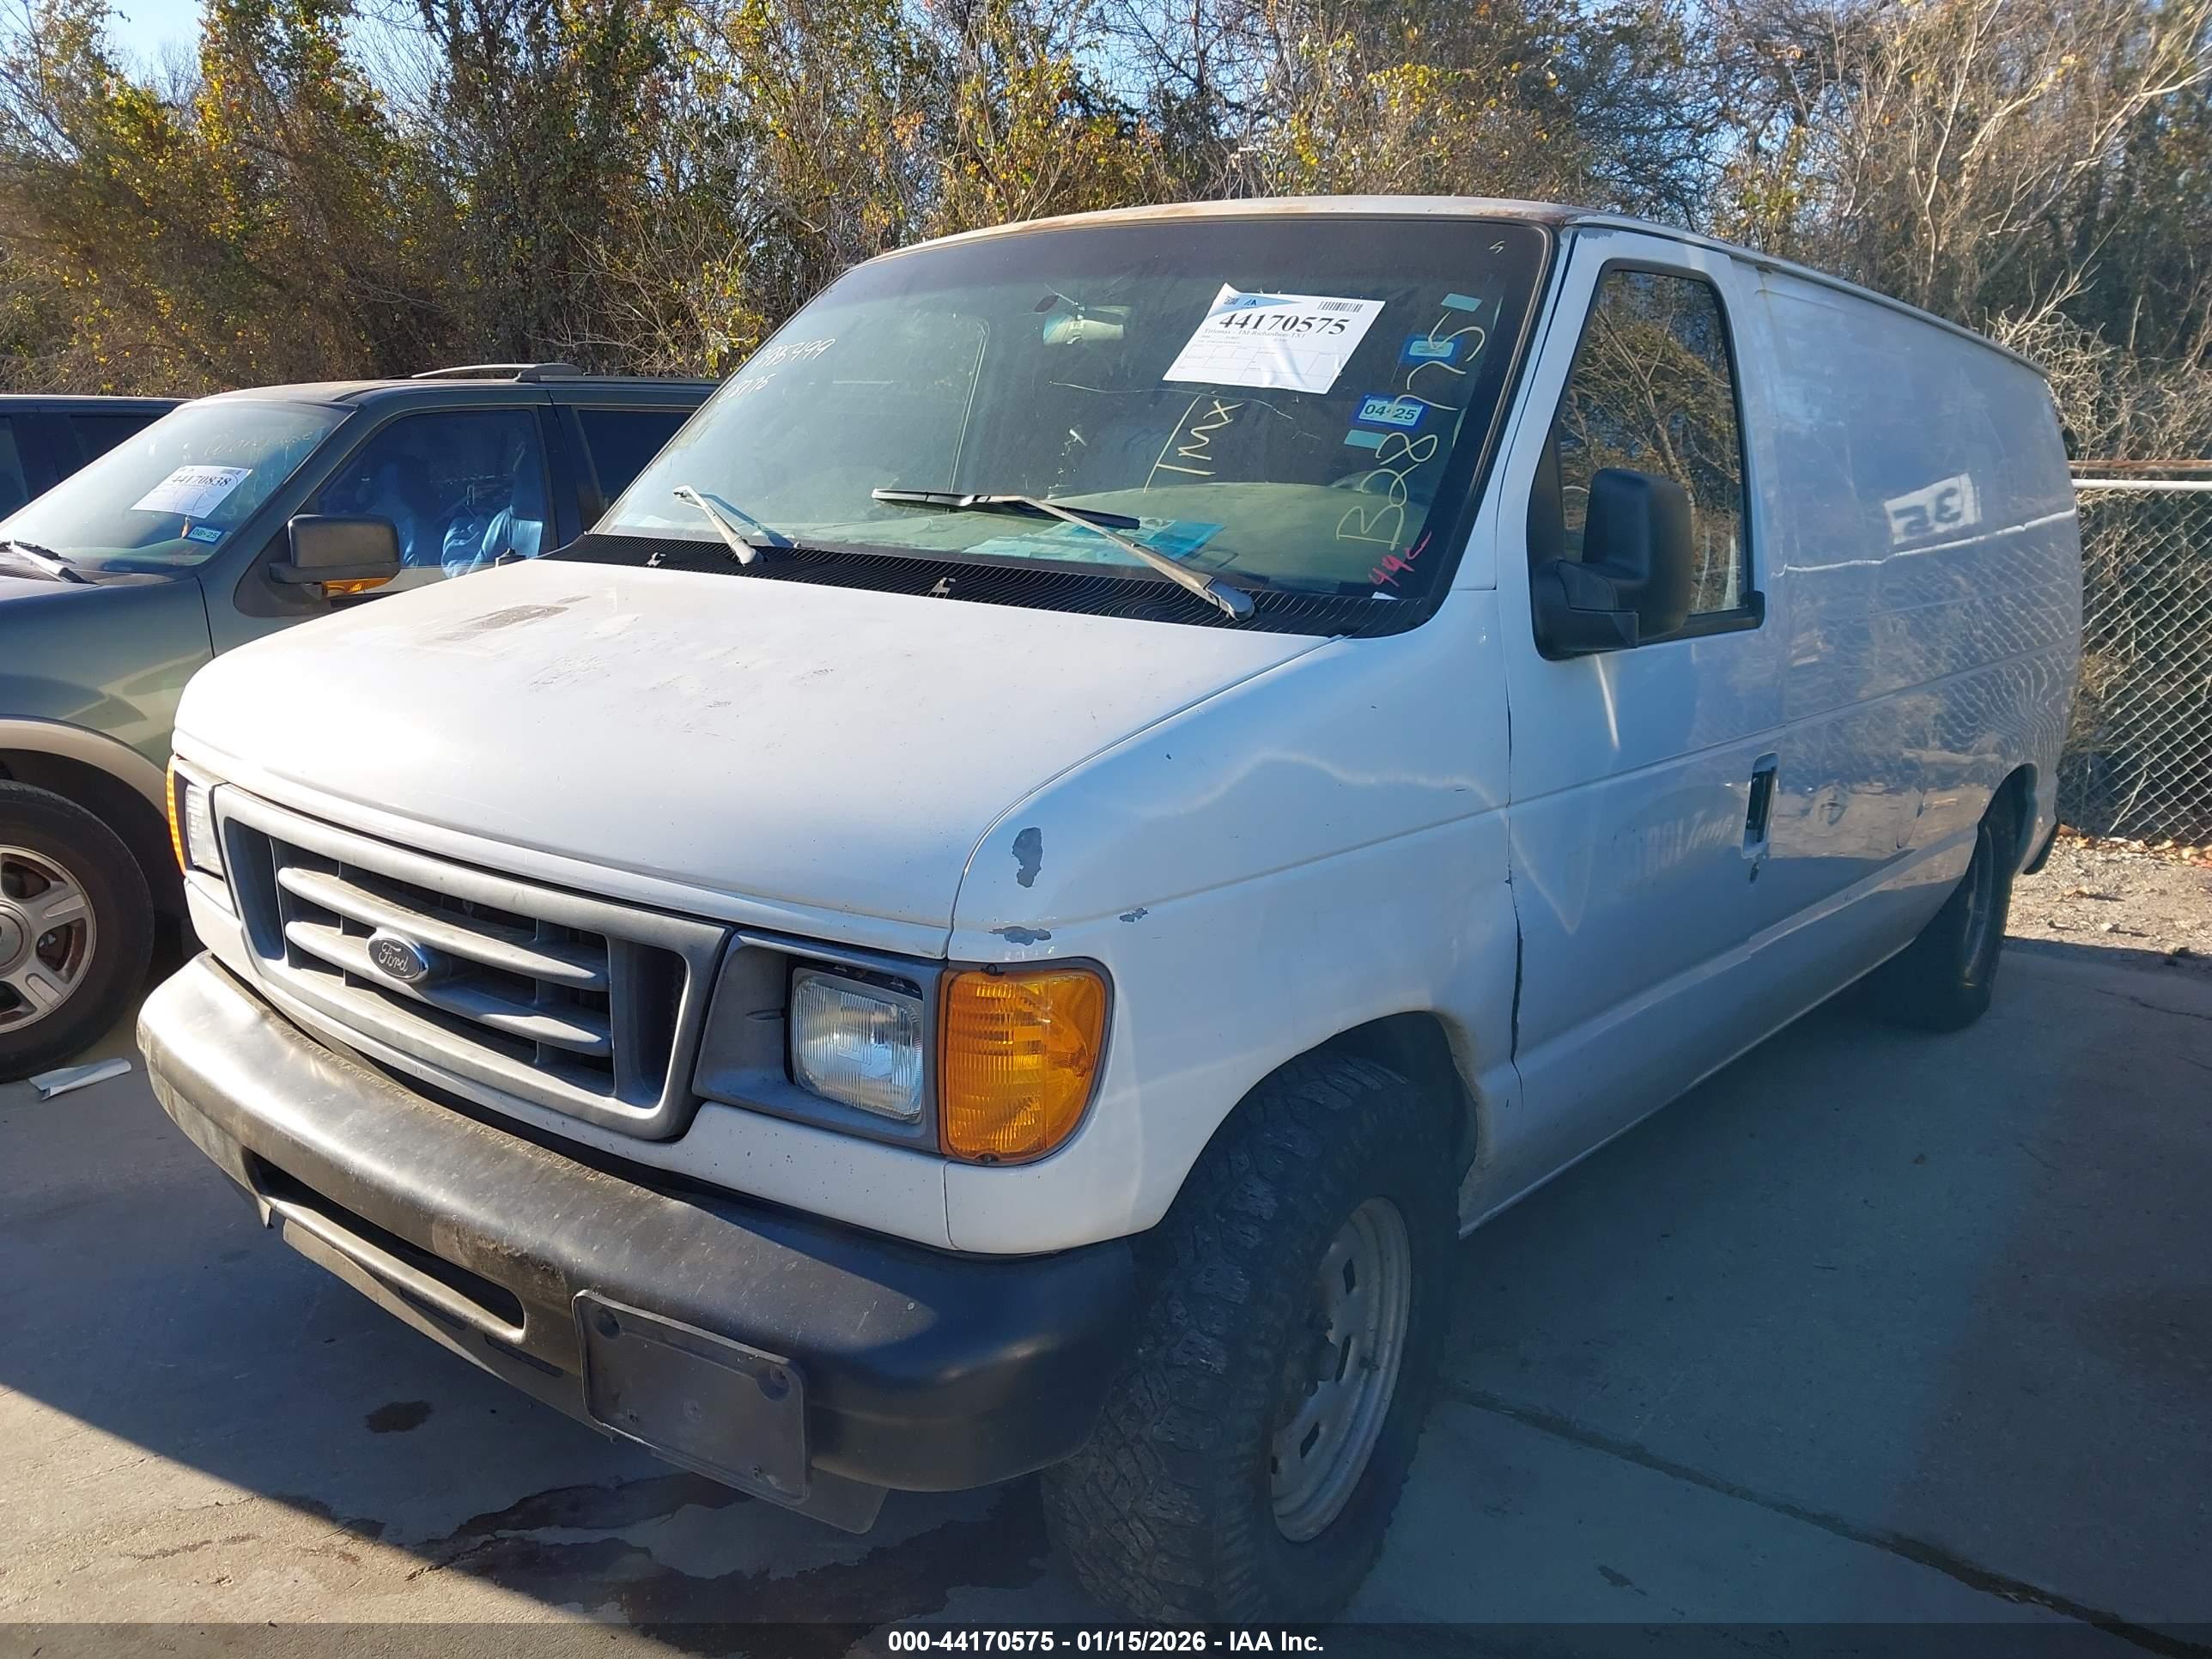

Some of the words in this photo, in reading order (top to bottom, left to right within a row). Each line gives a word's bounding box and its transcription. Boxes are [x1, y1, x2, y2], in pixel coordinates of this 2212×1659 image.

[1219, 313, 1352, 336] 44170575
[172, 474, 232, 487] 44170838
[378, 942, 409, 972] Ford
